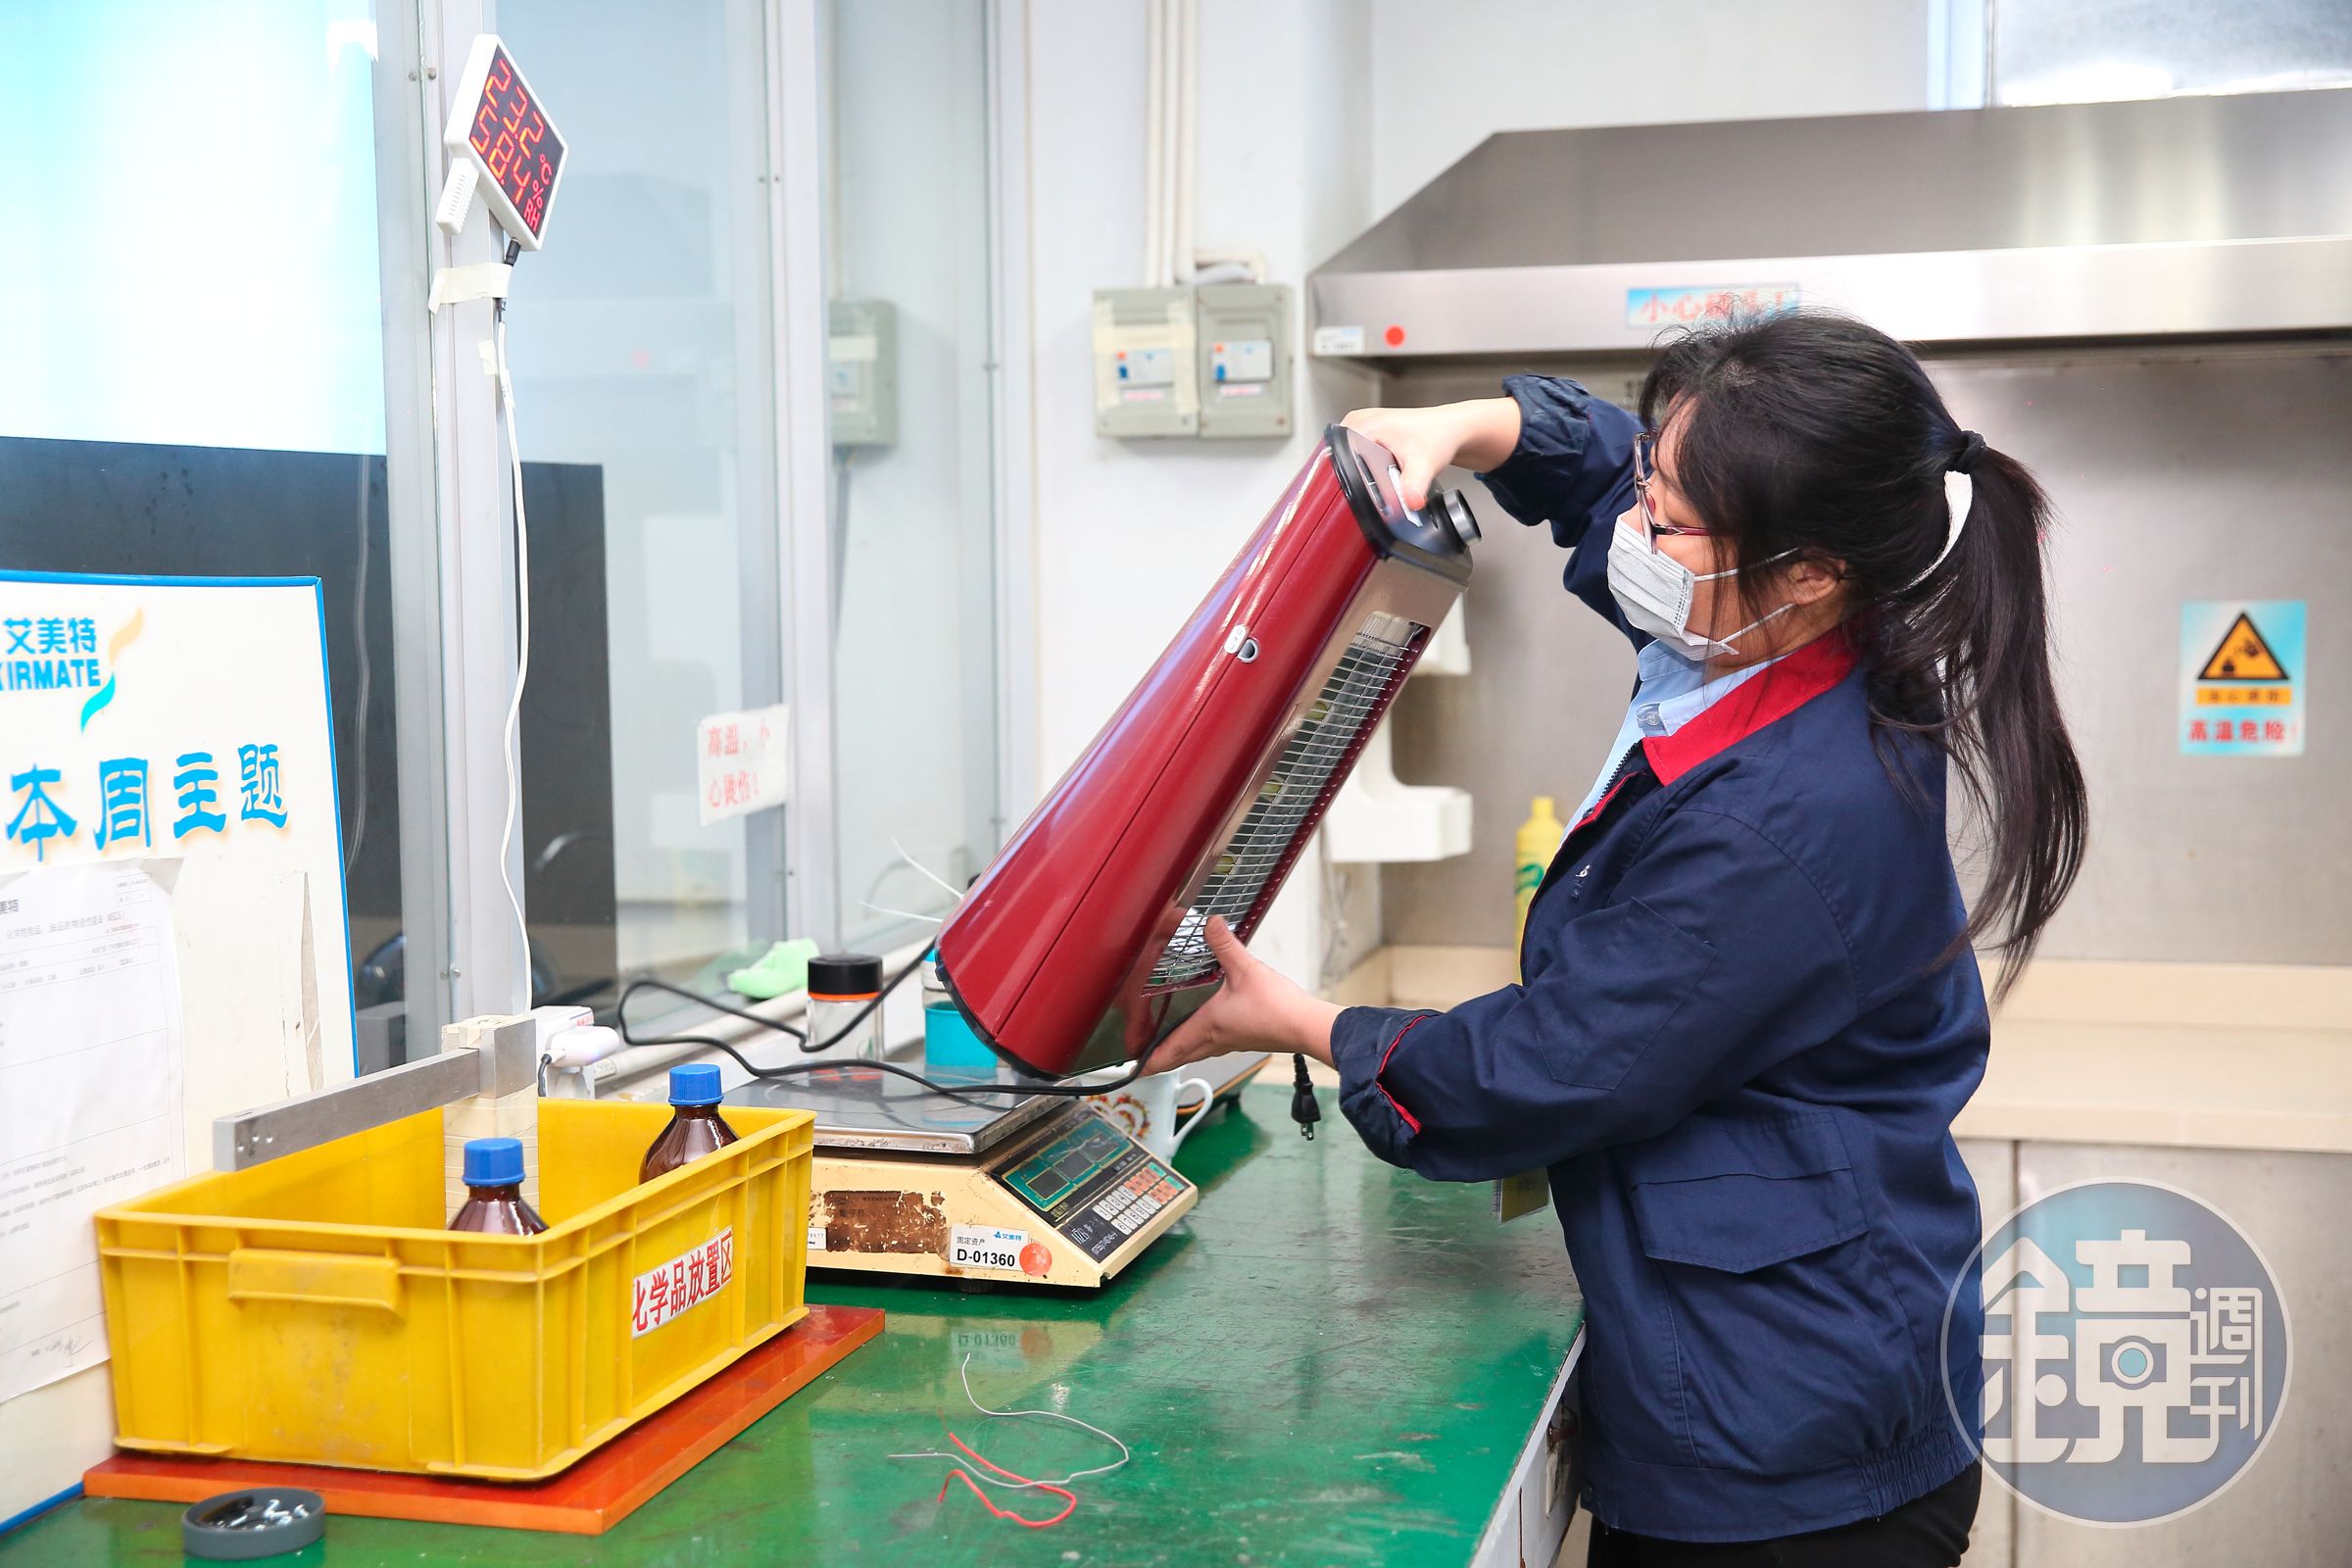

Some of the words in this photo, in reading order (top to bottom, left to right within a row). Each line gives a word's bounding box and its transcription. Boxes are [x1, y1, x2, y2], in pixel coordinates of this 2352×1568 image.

[485, 59, 545, 159] 23.2
[470, 105, 531, 205] 58.4
[4, 617, 96, 654] 艾美特
[0, 659, 101, 691] IRMATE
[5, 743, 289, 862] 本周主题
[956, 1236, 986, 1246] 固定资产
[956, 1248, 1015, 1267] D-01360
[632, 1230, 733, 1332] 化学品放置区
